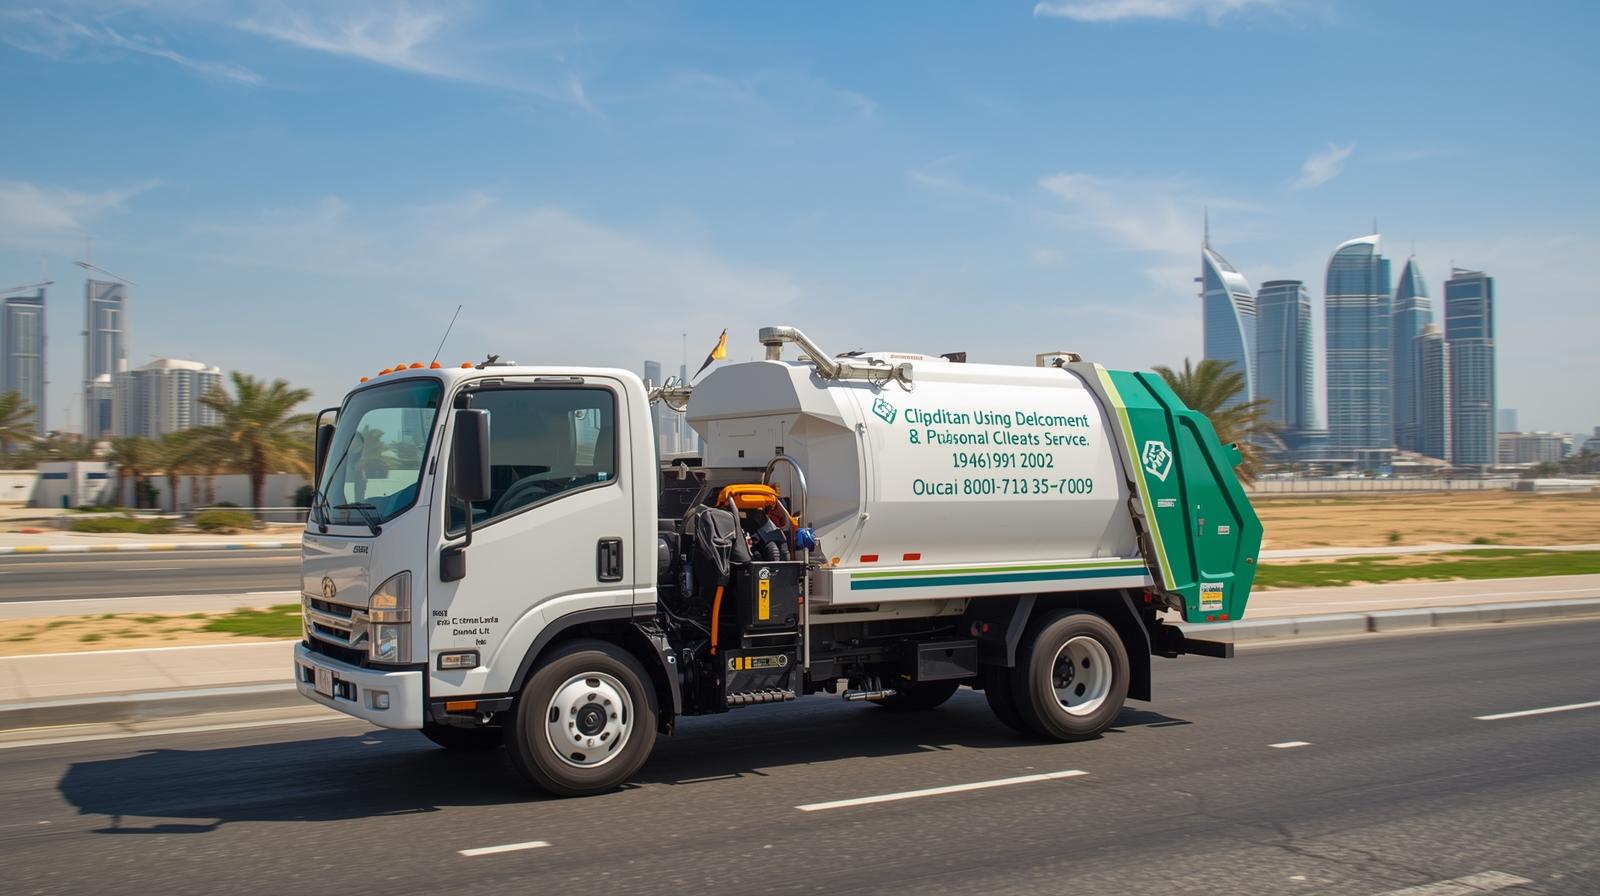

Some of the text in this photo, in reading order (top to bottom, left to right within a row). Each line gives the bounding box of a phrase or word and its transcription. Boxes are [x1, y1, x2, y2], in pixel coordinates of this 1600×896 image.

[973, 410, 1011, 428] Using
[1016, 411, 1090, 427] Delcoment
[1020, 452, 1054, 468] 2002
[912, 478, 958, 495] Oucai
